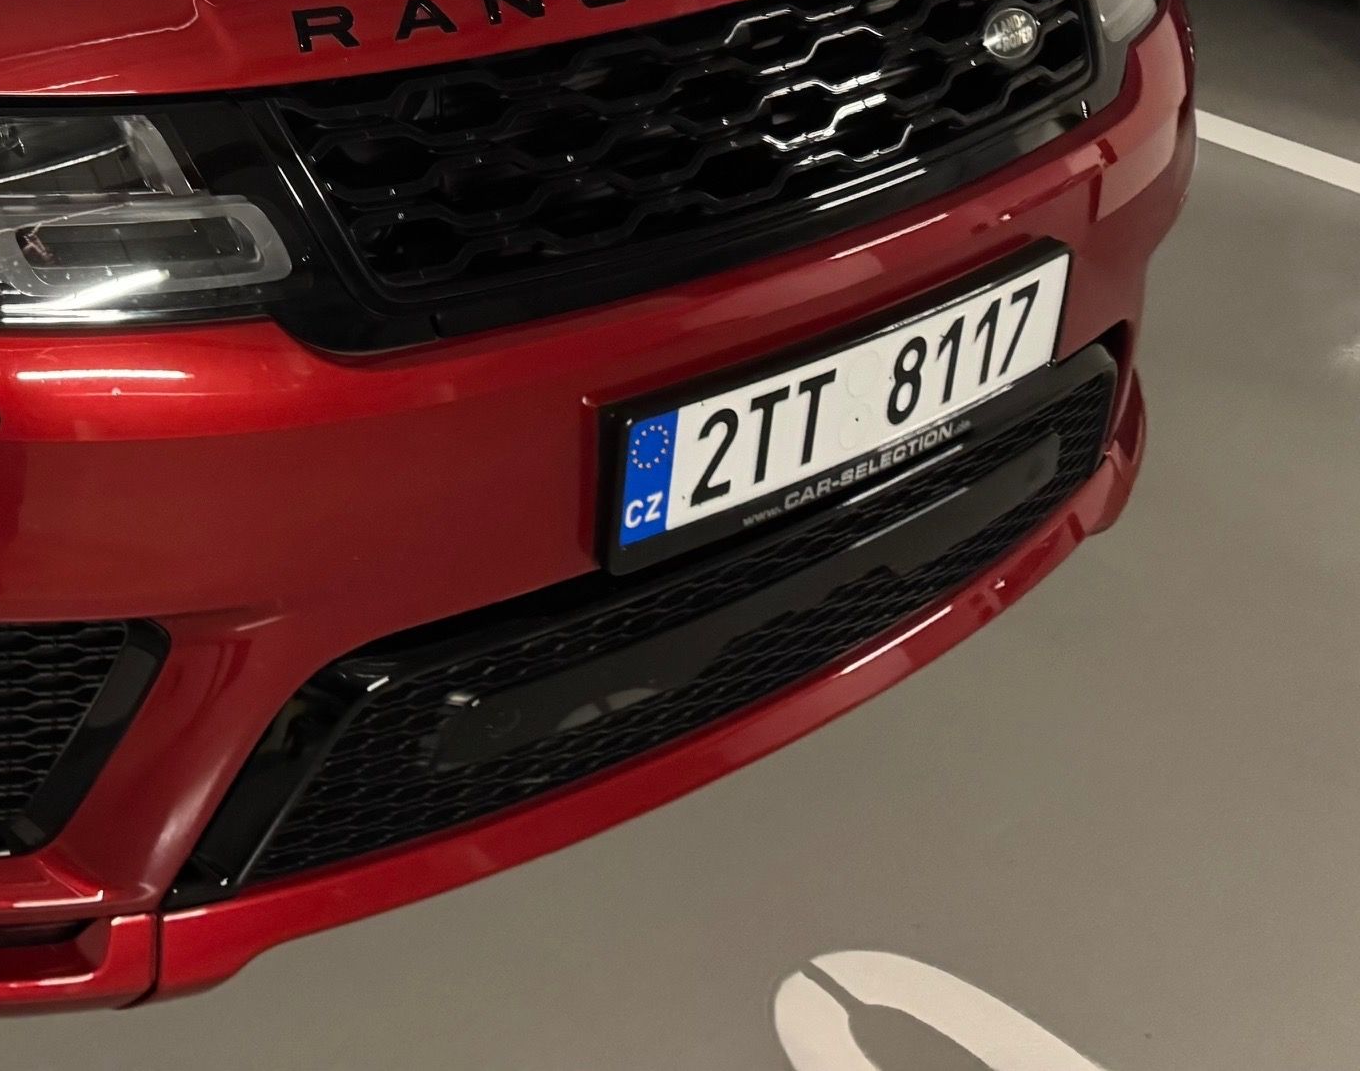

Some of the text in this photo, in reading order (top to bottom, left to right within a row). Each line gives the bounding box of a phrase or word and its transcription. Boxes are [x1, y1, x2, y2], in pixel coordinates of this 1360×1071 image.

[690, 279, 1041, 508] 2TT 8117
[624, 490, 663, 529] CZ
